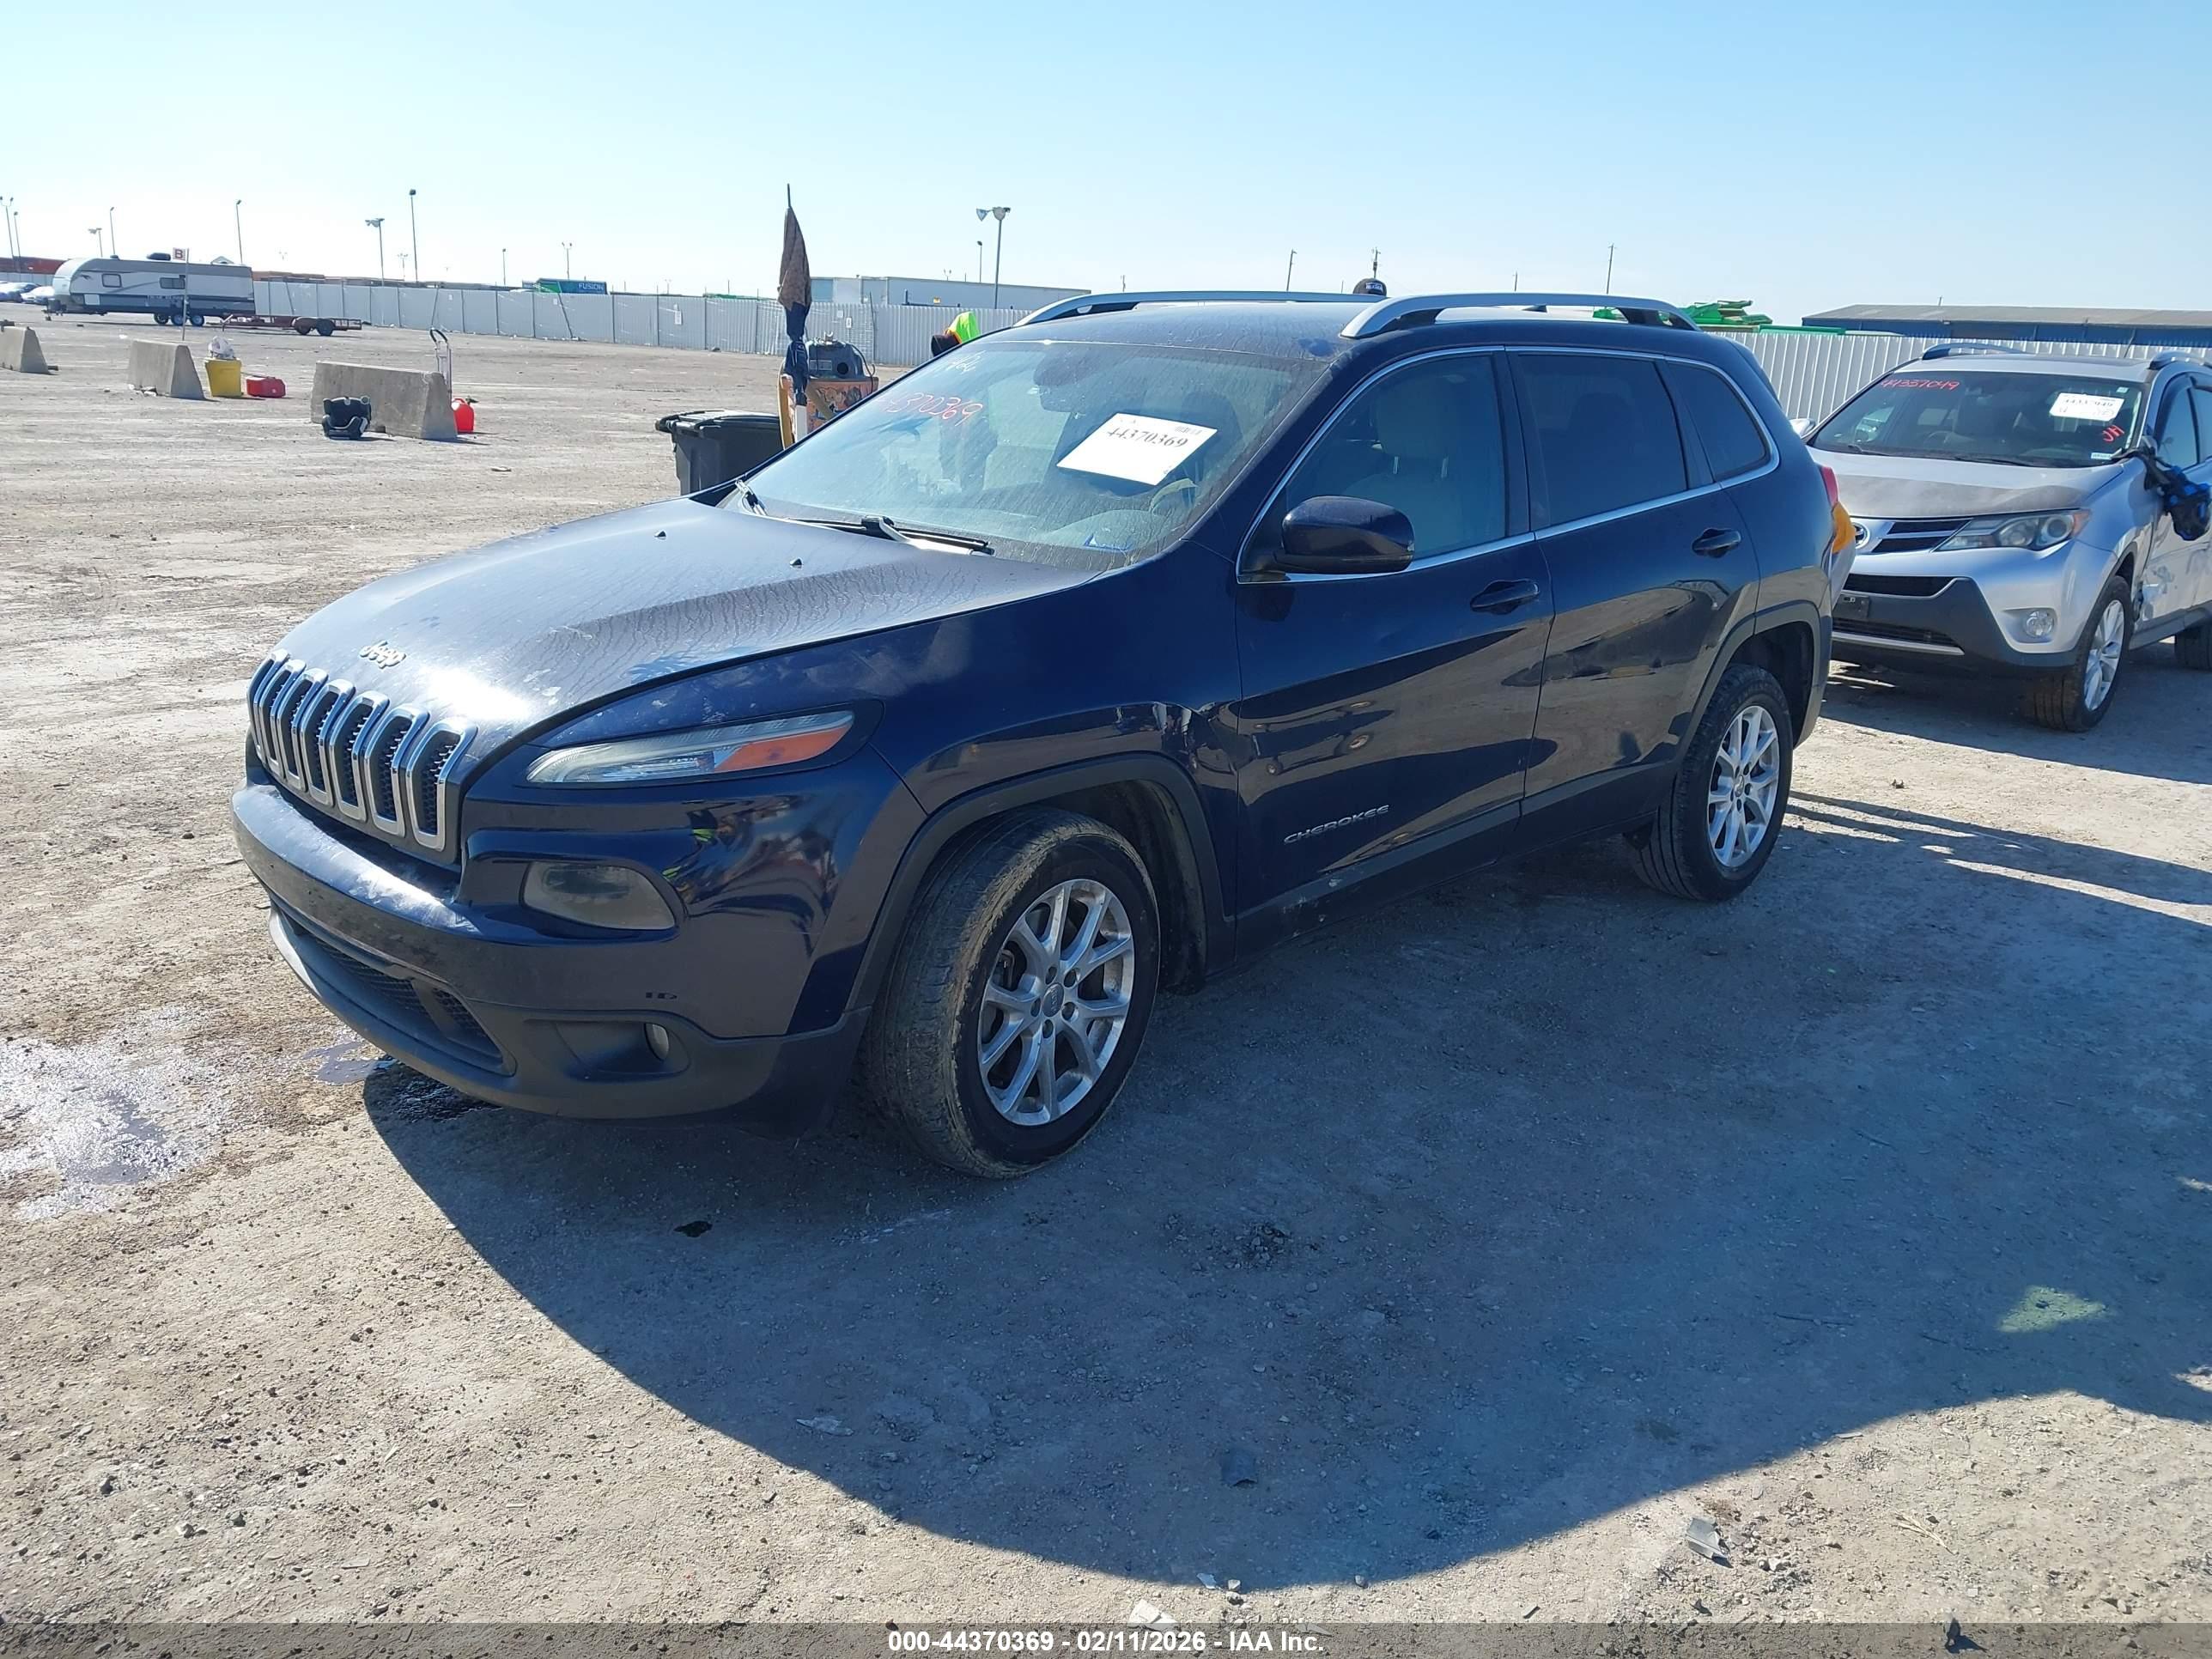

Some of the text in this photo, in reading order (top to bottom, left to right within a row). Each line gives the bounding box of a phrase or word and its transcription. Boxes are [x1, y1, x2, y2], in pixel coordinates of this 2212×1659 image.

[174, 248, 184, 259] B
[578, 282, 605, 291] FUSION
[1103, 427, 1188, 447] 44370369
[359, 640, 407, 670] Jeep
[1283, 805, 1389, 844] CHEROKEE
